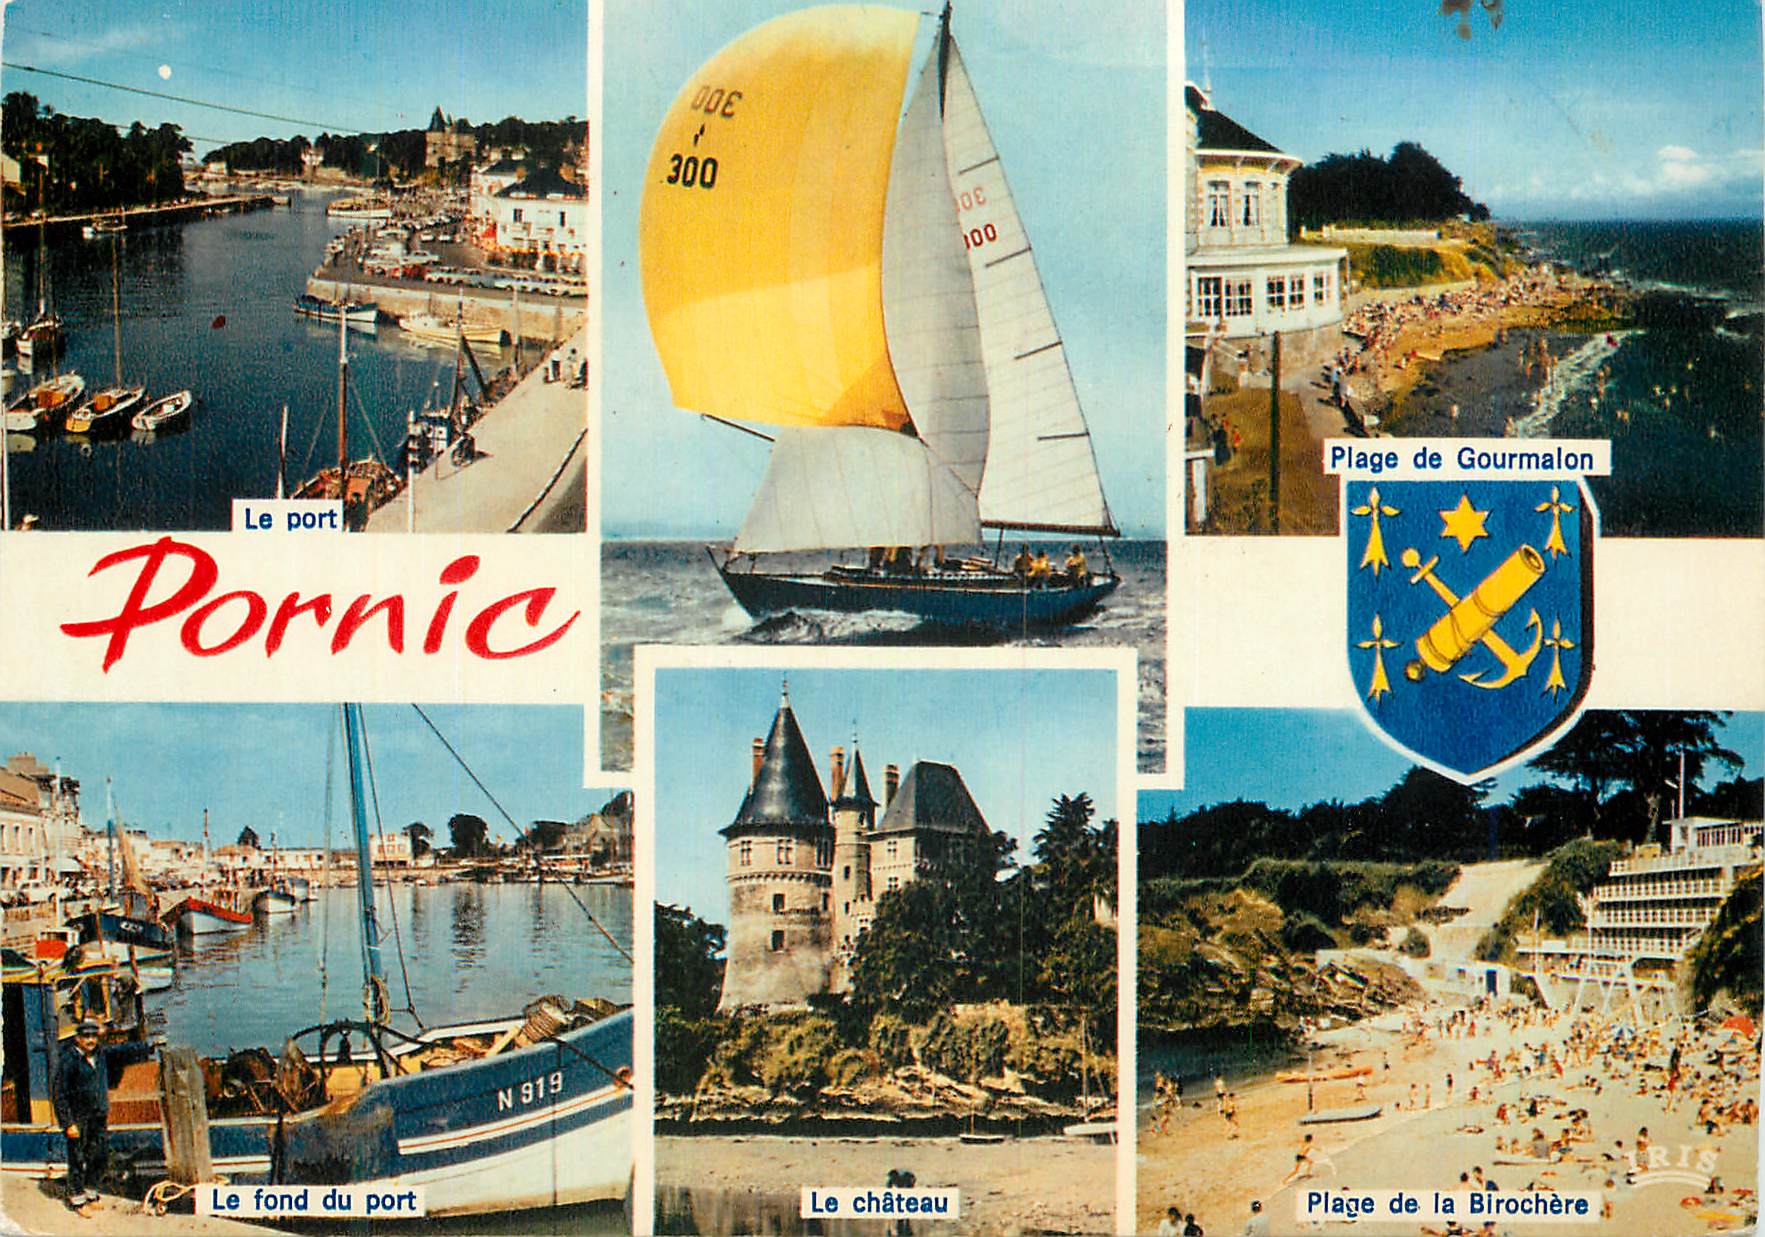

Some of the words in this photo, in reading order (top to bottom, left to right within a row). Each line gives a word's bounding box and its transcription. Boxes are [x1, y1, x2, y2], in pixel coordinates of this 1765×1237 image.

[667, 153, 718, 189] 300
[498, 1088, 513, 1111] N
[522, 1071, 562, 1104] 919
